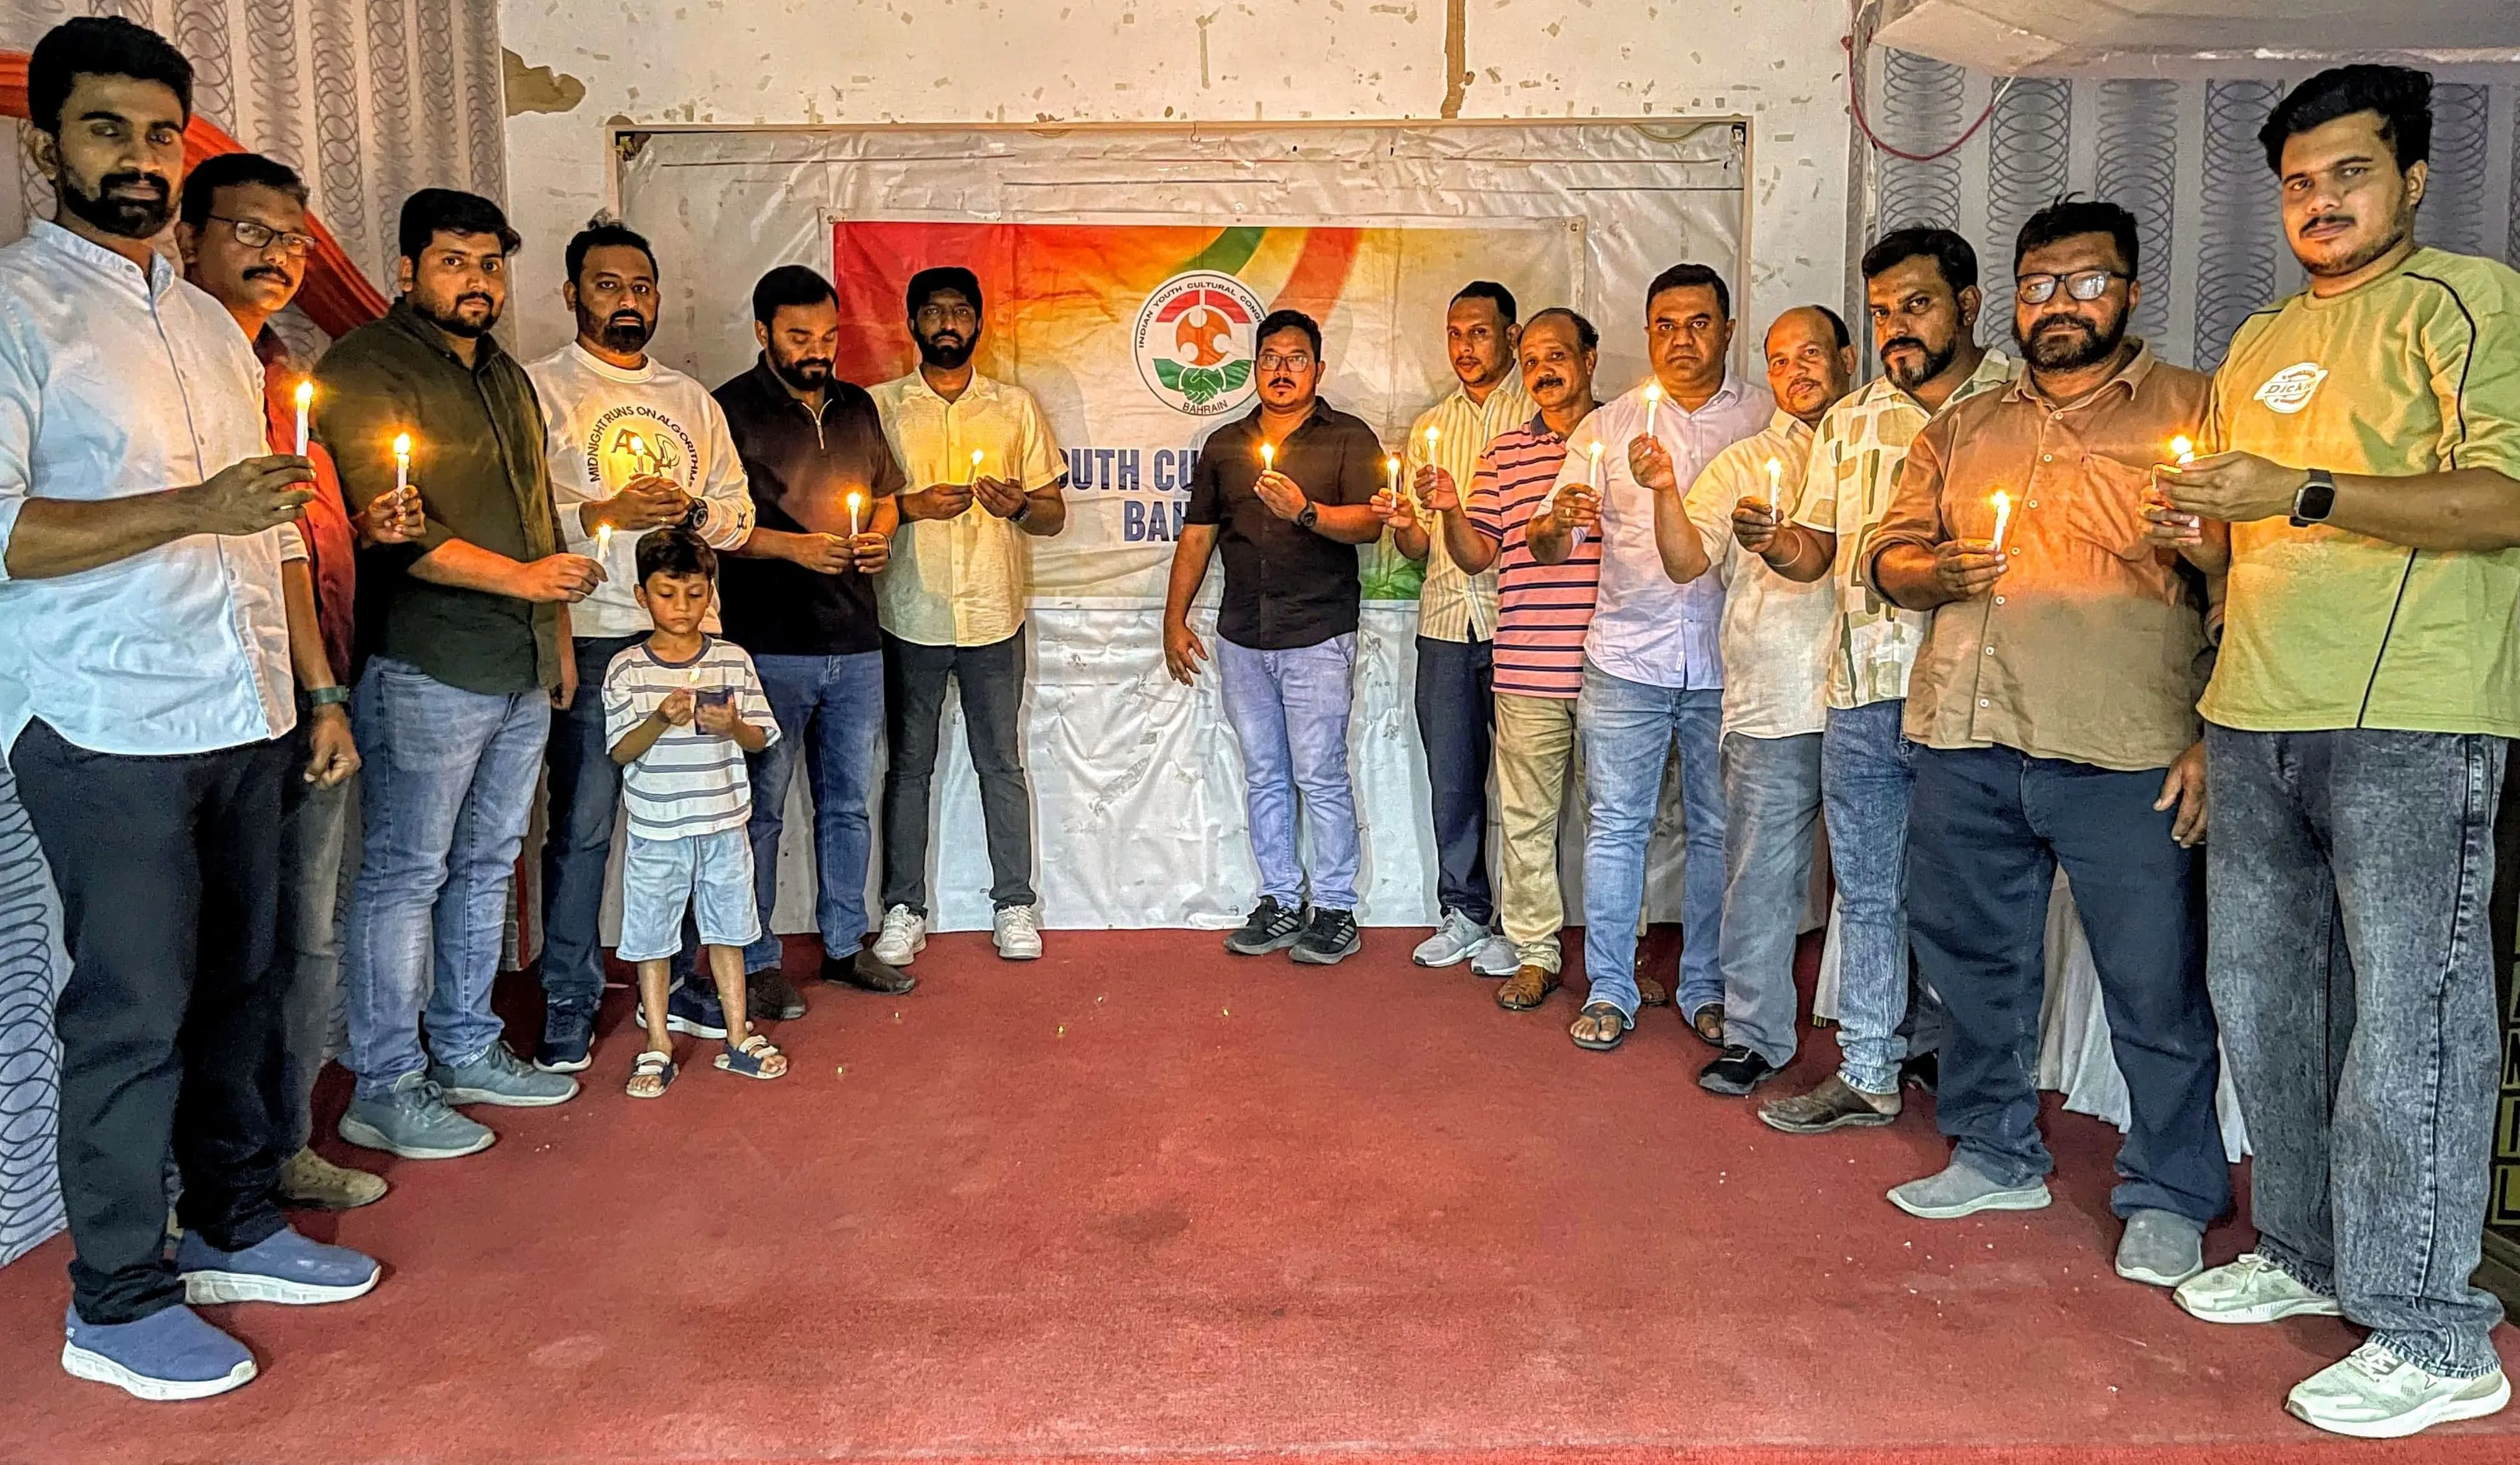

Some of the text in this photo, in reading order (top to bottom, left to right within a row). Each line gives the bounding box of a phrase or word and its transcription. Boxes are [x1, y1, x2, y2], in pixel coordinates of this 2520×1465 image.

[1138, 311, 1154, 348] INDIAN
[1153, 285, 1183, 307] YOUTH
[1187, 281, 1237, 296] CULTURAL
[1182, 399, 1228, 415] BAHRAIN
[587, 418, 608, 483] MIDNIGHT
[603, 406, 634, 423] RUNS
[636, 406, 656, 419] ON
